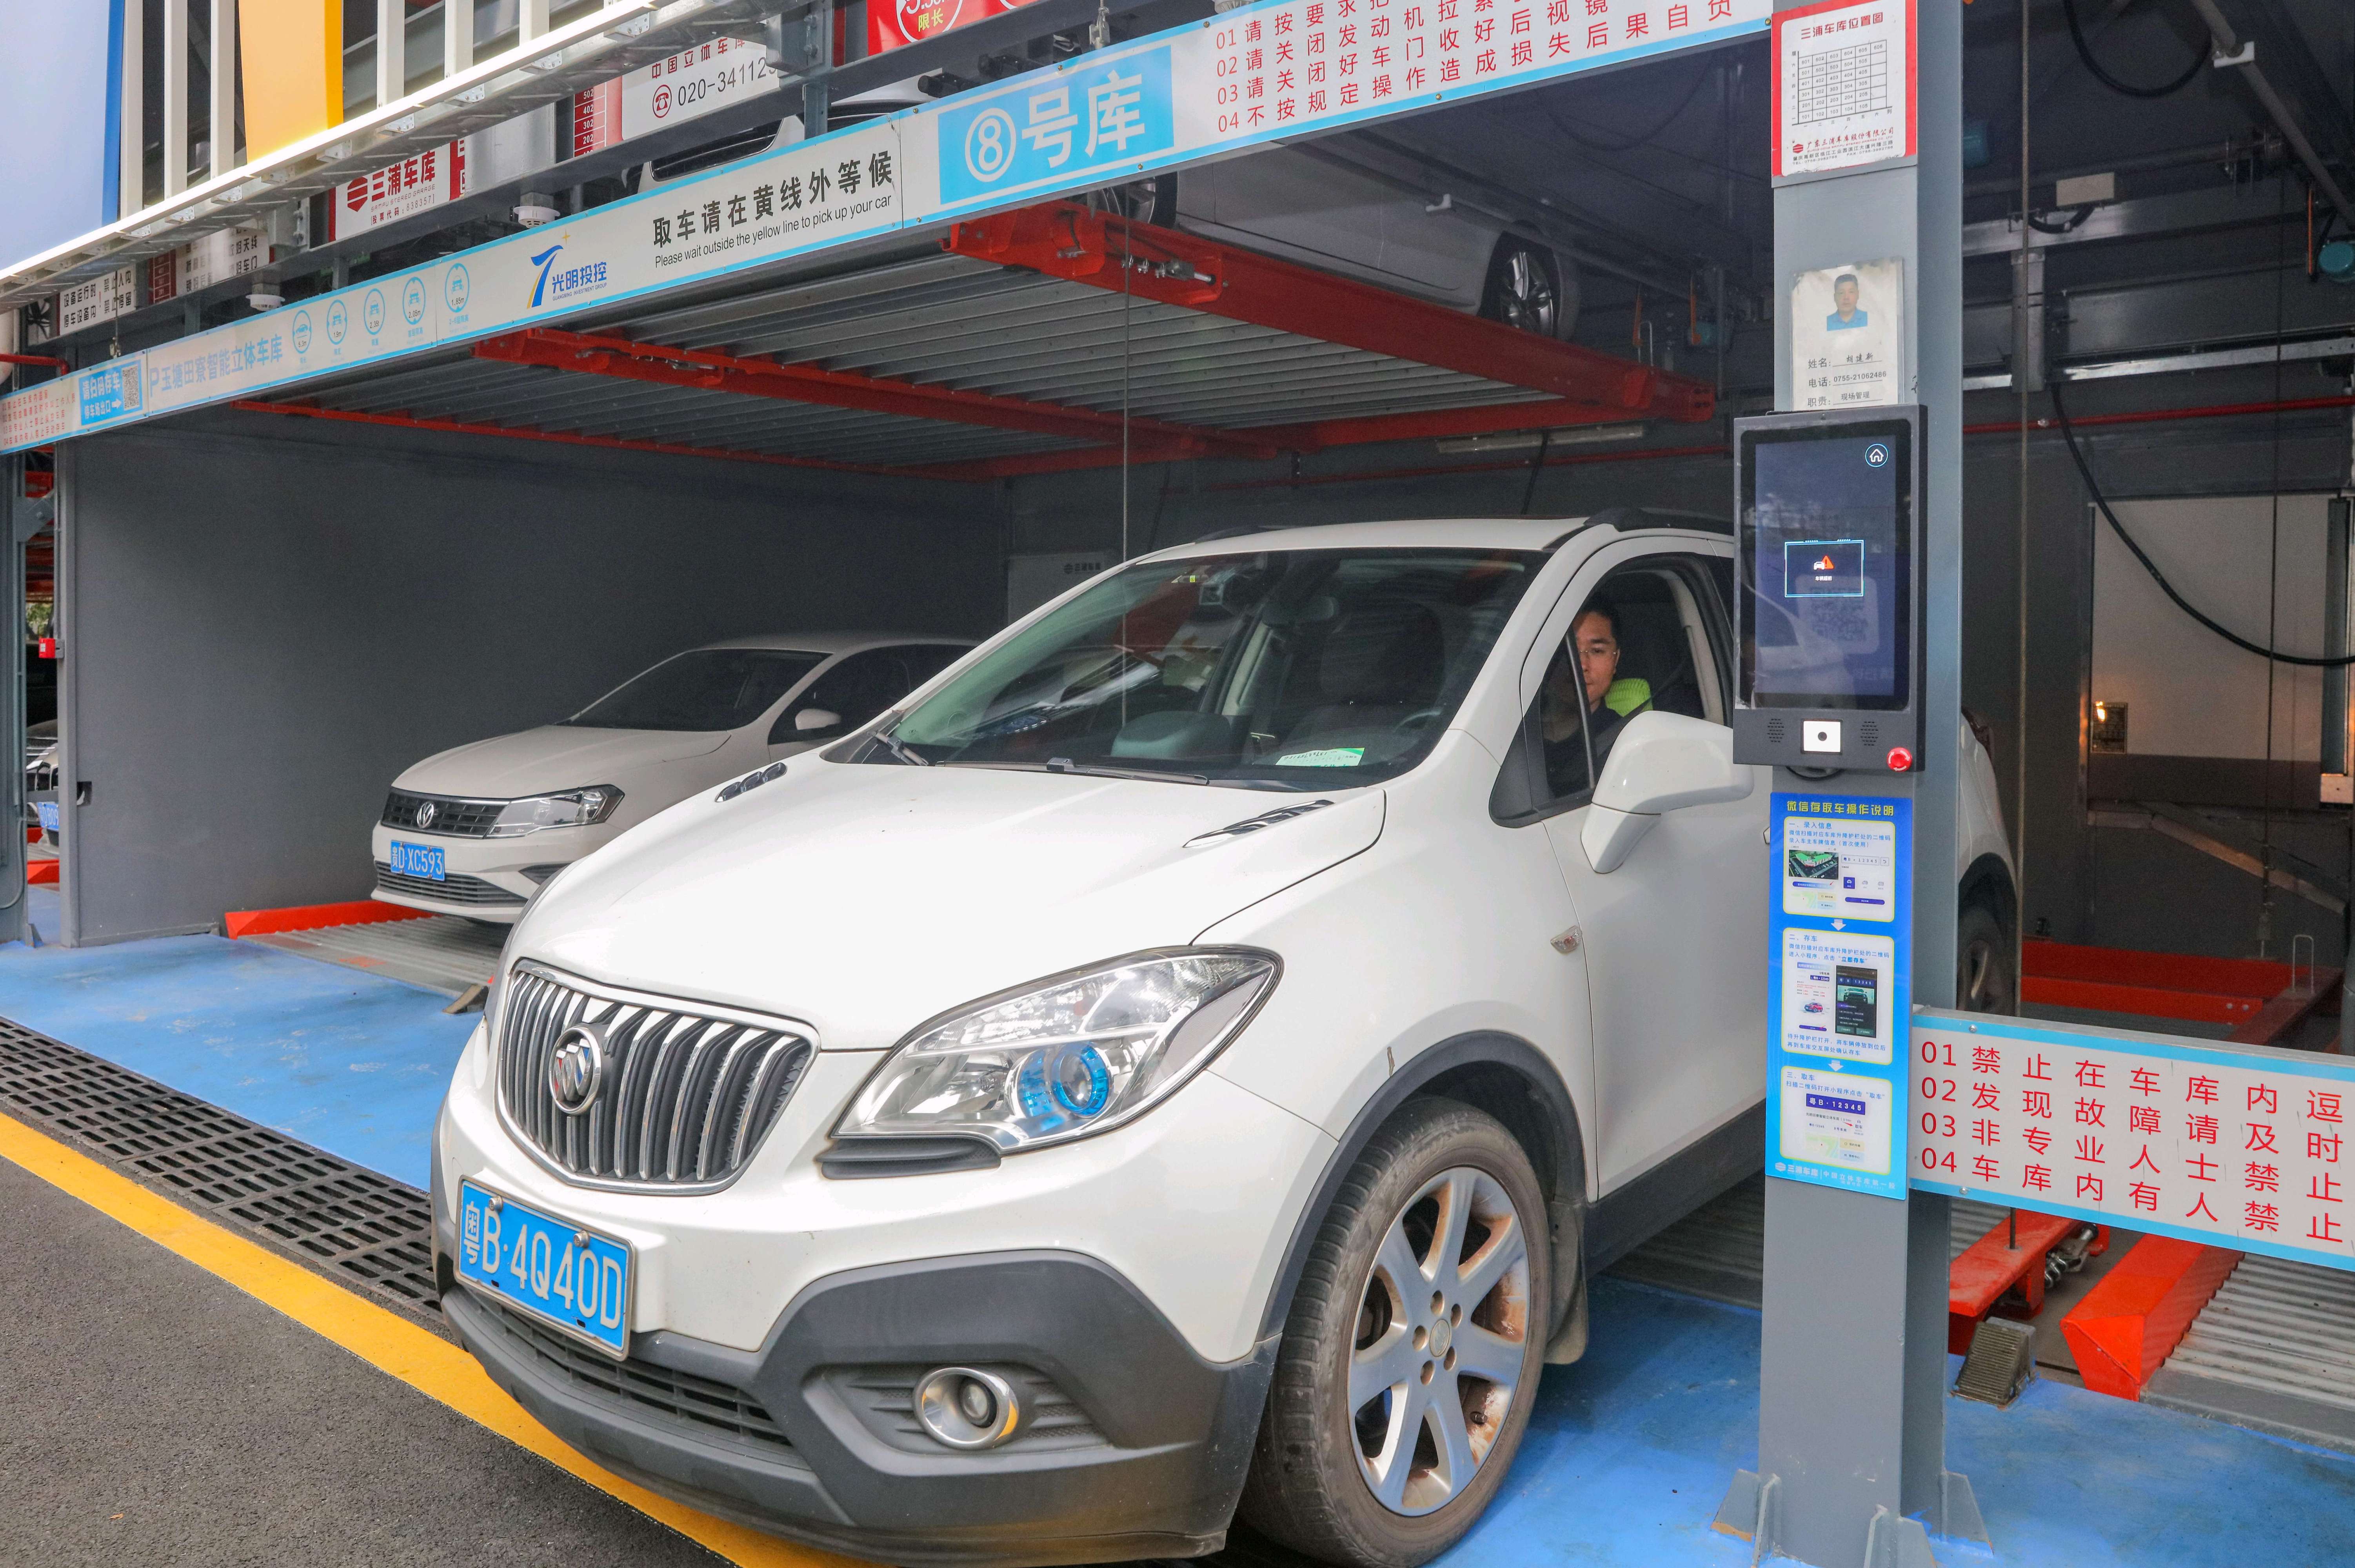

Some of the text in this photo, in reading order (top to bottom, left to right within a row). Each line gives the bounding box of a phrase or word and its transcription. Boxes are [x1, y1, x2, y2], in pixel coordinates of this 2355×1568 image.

[918, 8, 943, 32] 限长
[1801, 12, 1883, 39] 三浦车库位置图
[1216, 29, 1237, 50] 01
[1217, 56, 1237, 77] 02
[583, 89, 594, 100] 502
[1217, 84, 1238, 105] 03
[583, 104, 594, 114] 402
[583, 119, 594, 130] 302
[1218, 112, 1239, 132] 04
[583, 134, 594, 145] 202
[372, 150, 435, 202] 三浦车库
[371, 201, 389, 212] SAMPU
[413, 184, 435, 195] GARAGE
[653, 151, 892, 248] 取车请在黄线外等候
[655, 195, 892, 268] Please wait outside the yellow line to pick up your car
[552, 261, 607, 294] 光明投控
[451, 298, 464, 306] 1.85m
[552, 292, 572, 301] GUANGMING
[573, 286, 594, 296] INVESTMENT
[409, 310, 421, 318] 2.05m
[1833, 371, 1886, 382] 0755-21062486
[1841, 391, 1870, 401] 现场管理
[1787, 800, 1894, 816] 微信存取车操作说明
[1789, 830, 1891, 841] 微信扫描对应车库升降护栏处的二维码
[1789, 943, 1890, 958] 微信扫描对应车库升降护栏处的二维码
[1787, 1041, 1861, 1056] 再到车库交互屏处确认存车
[1921, 1041, 1957, 1066] 01
[1921, 1077, 2343, 1162] 02 发现故障请及时
[1921, 1112, 2343, 1202] 03 非专业人士禁止
[1921, 1148, 2343, 1243] 04 车库内有人禁止
